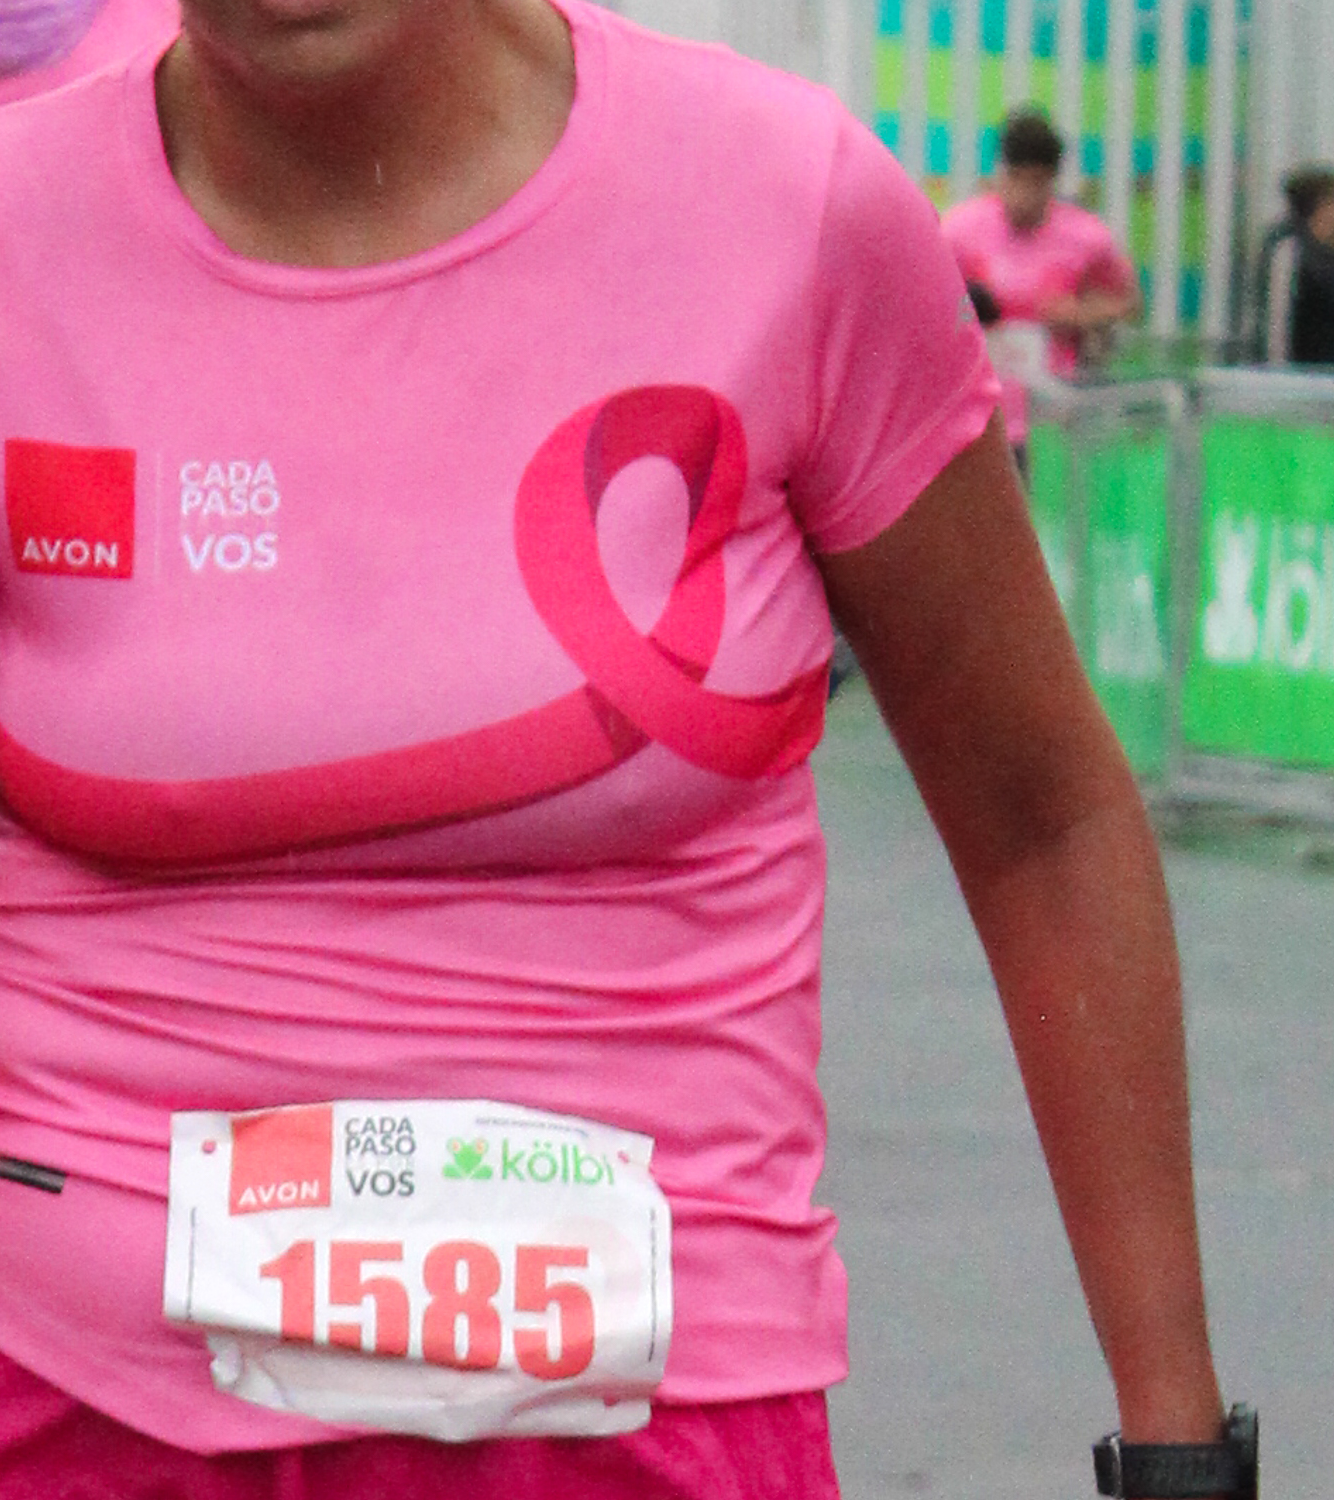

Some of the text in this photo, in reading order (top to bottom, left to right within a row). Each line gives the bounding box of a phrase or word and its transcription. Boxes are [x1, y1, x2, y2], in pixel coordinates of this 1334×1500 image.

[180, 460, 276, 486] CADA
[181, 485, 280, 515] PASO
[20, 537, 119, 568] AVON
[181, 532, 278, 572] VOS
[345, 1117, 414, 1135] CADA
[346, 1134, 417, 1156] PASO
[501, 1139, 615, 1186] kölbi
[238, 1180, 319, 1207] AVON
[346, 1170, 415, 1197] VOS
[259, 1239, 595, 1381] 1585
